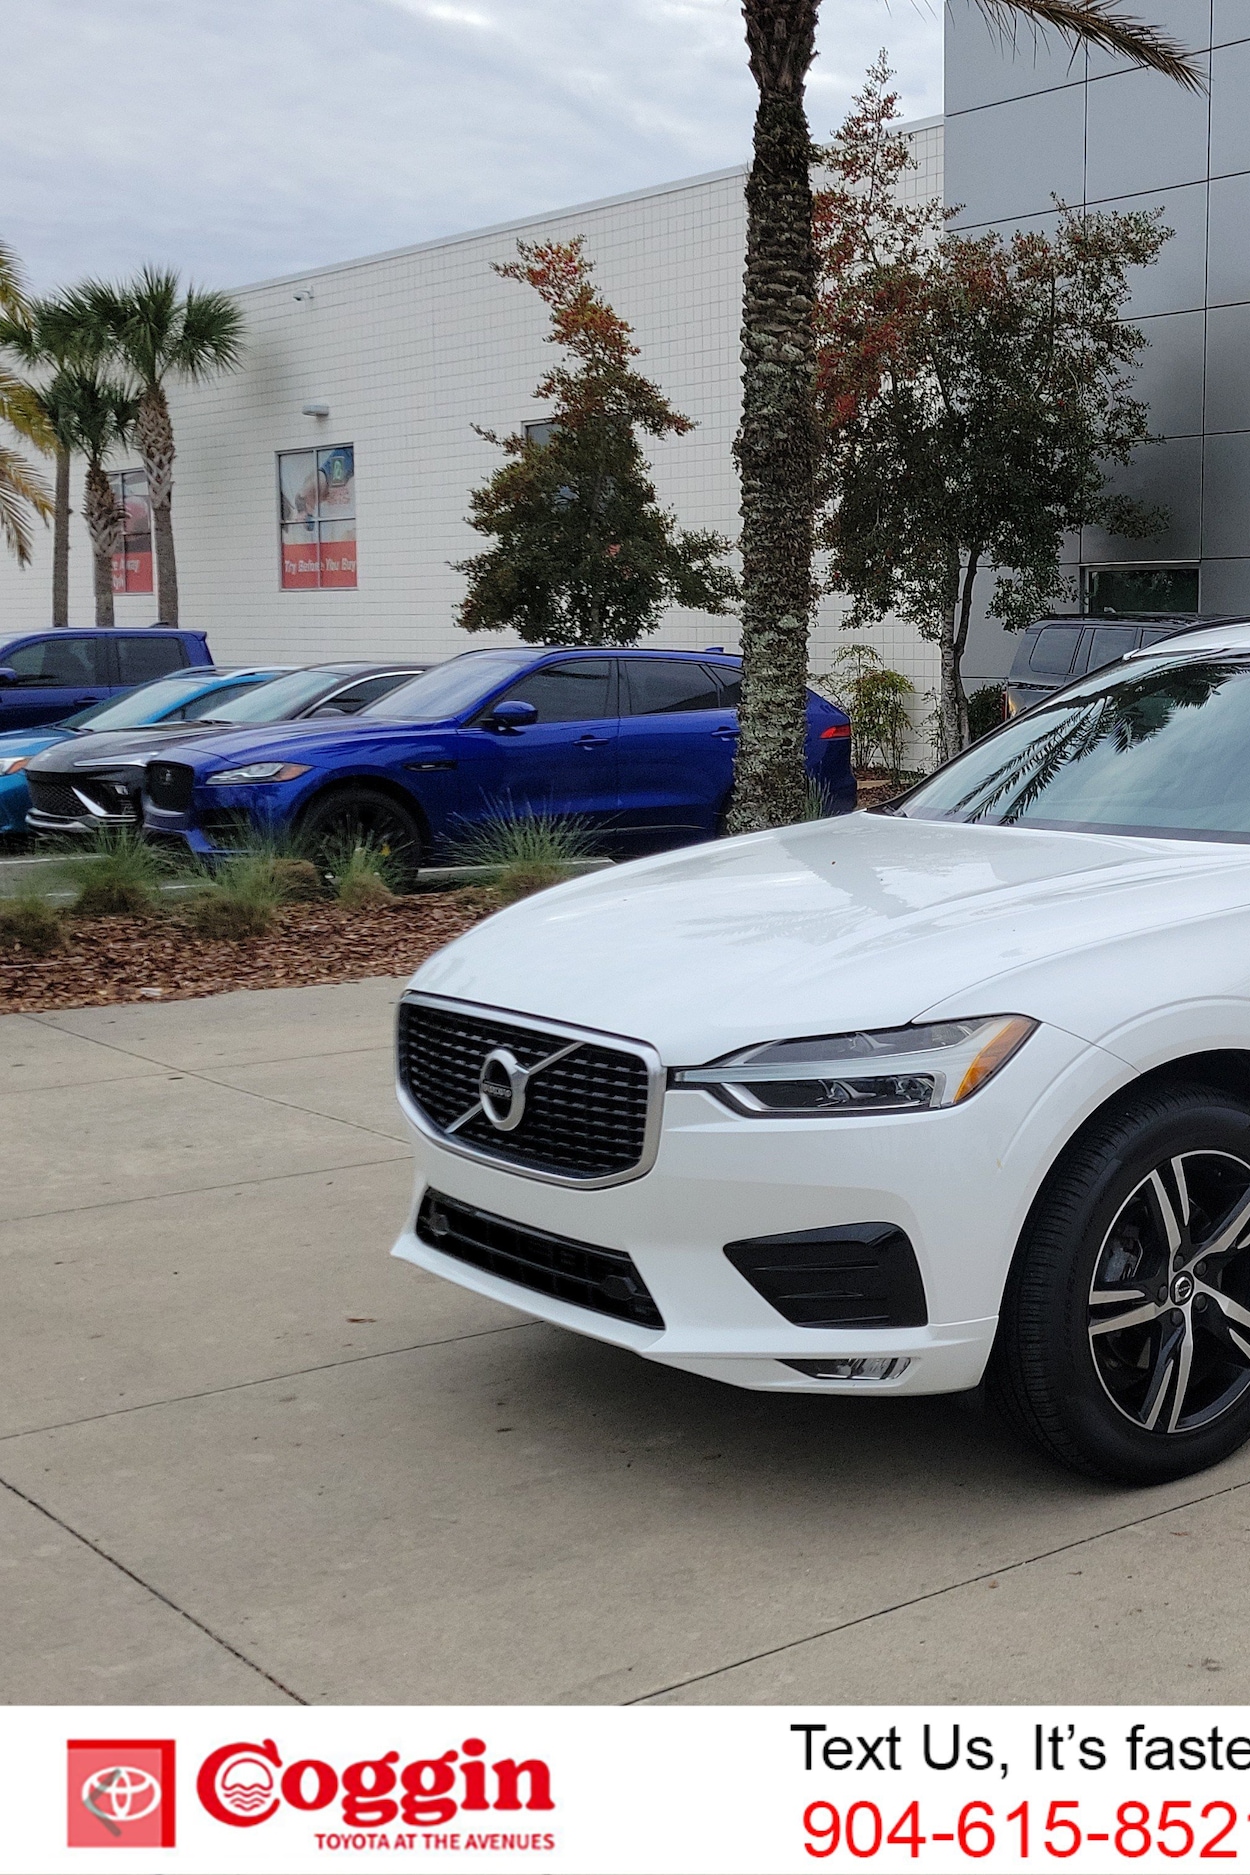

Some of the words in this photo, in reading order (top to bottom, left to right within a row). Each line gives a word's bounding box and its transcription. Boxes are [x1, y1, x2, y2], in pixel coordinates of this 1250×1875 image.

[284, 560, 297, 575] Try
[326, 558, 340, 571] You
[341, 558, 356, 572] Buy
